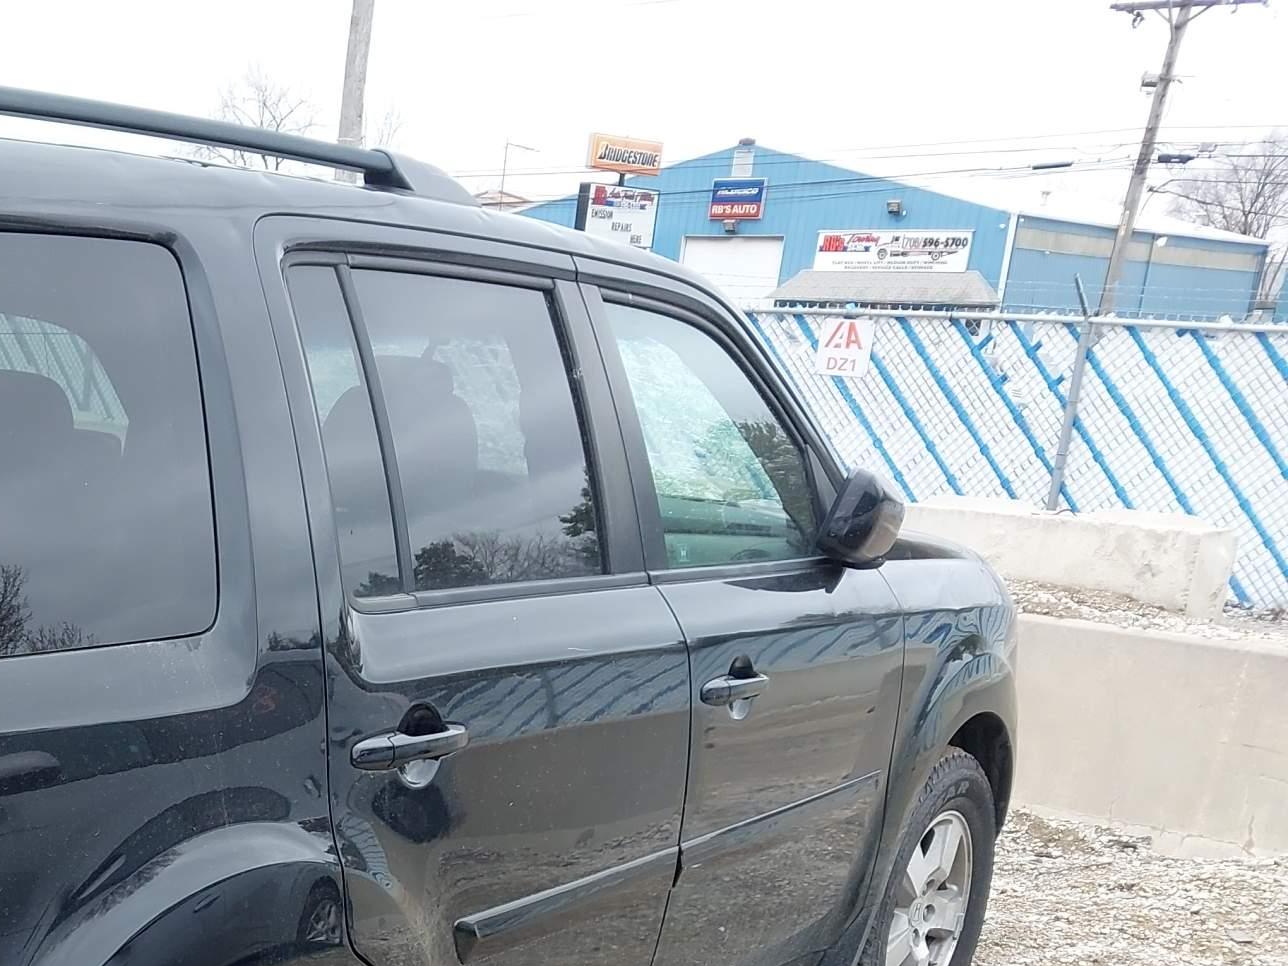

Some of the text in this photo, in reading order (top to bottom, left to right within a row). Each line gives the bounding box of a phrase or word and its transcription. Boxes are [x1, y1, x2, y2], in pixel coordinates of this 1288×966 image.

[598, 143, 659, 168] BRIDGESTONE
[591, 208, 613, 219] EMISSION
[711, 204, 757, 214] RB'S AUTO
[611, 222, 632, 232] REPAIRS
[826, 356, 857, 371] DZ1
